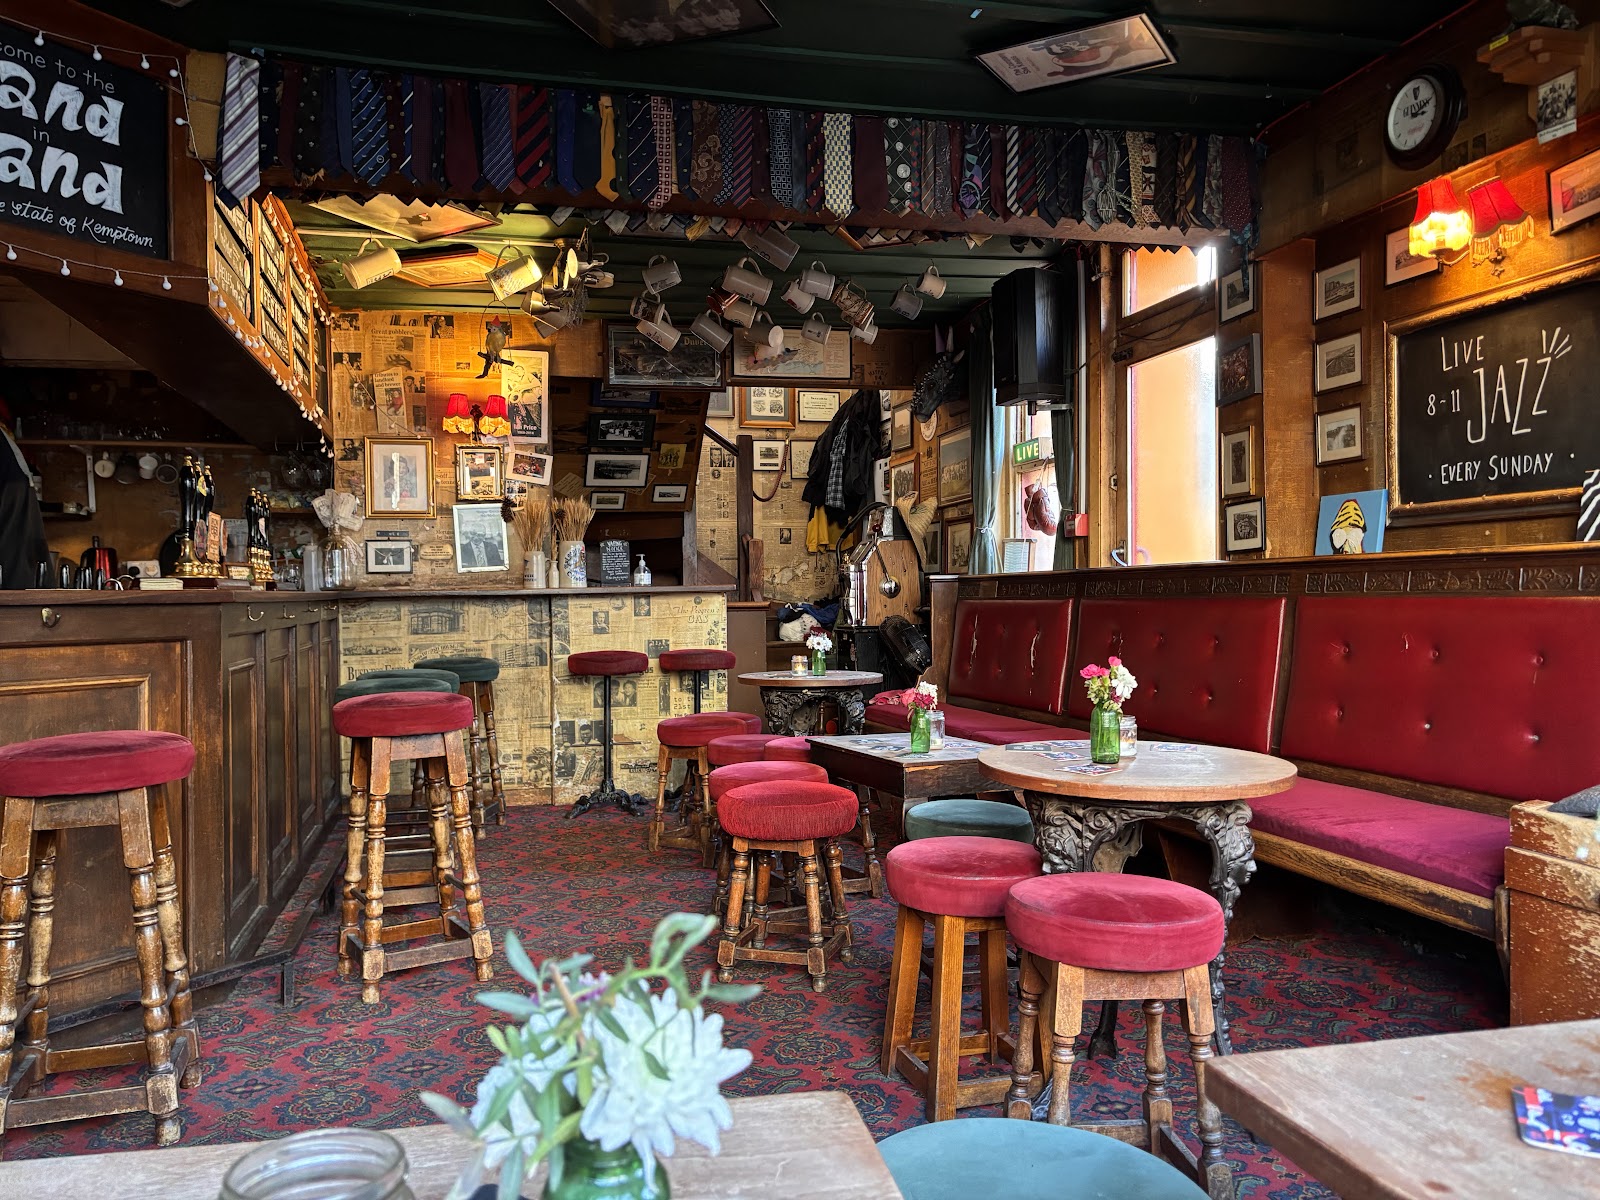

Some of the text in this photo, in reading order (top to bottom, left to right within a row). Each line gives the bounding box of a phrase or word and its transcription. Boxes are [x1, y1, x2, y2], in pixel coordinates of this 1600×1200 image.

[0, 42, 115, 94] ome to the
[33, 126, 50, 143] in
[59, 216, 77, 235] of
[81, 216, 154, 248] Kemptown
[1441, 335, 1485, 372] LIVE
[1466, 357, 1552, 444] JAZZ
[1016, 442, 1039, 462] LIVE
[1441, 453, 1553, 485] EVERY SUNDAY
